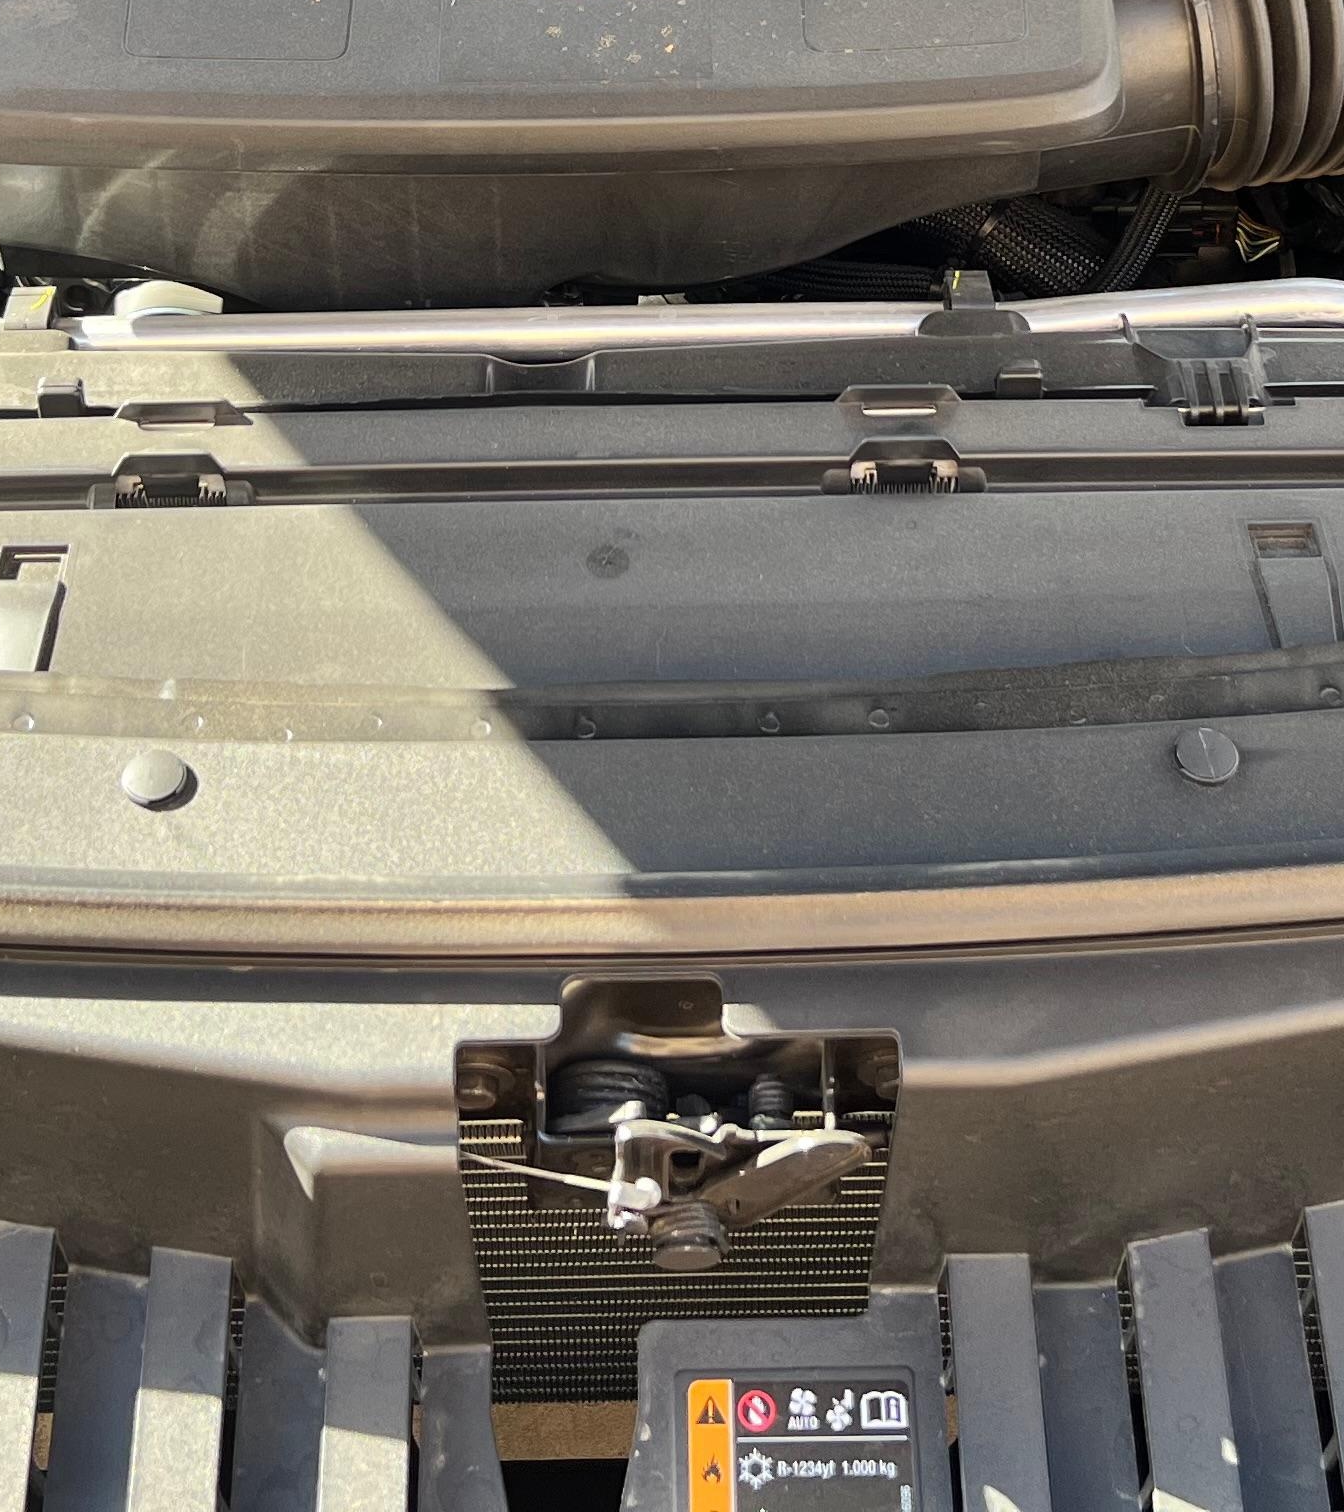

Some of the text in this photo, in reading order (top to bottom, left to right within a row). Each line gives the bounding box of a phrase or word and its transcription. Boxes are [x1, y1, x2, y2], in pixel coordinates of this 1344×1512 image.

[788, 1416, 819, 1430] AUTO
[777, 1460, 897, 1479] R-1234yf 1.000 kg
